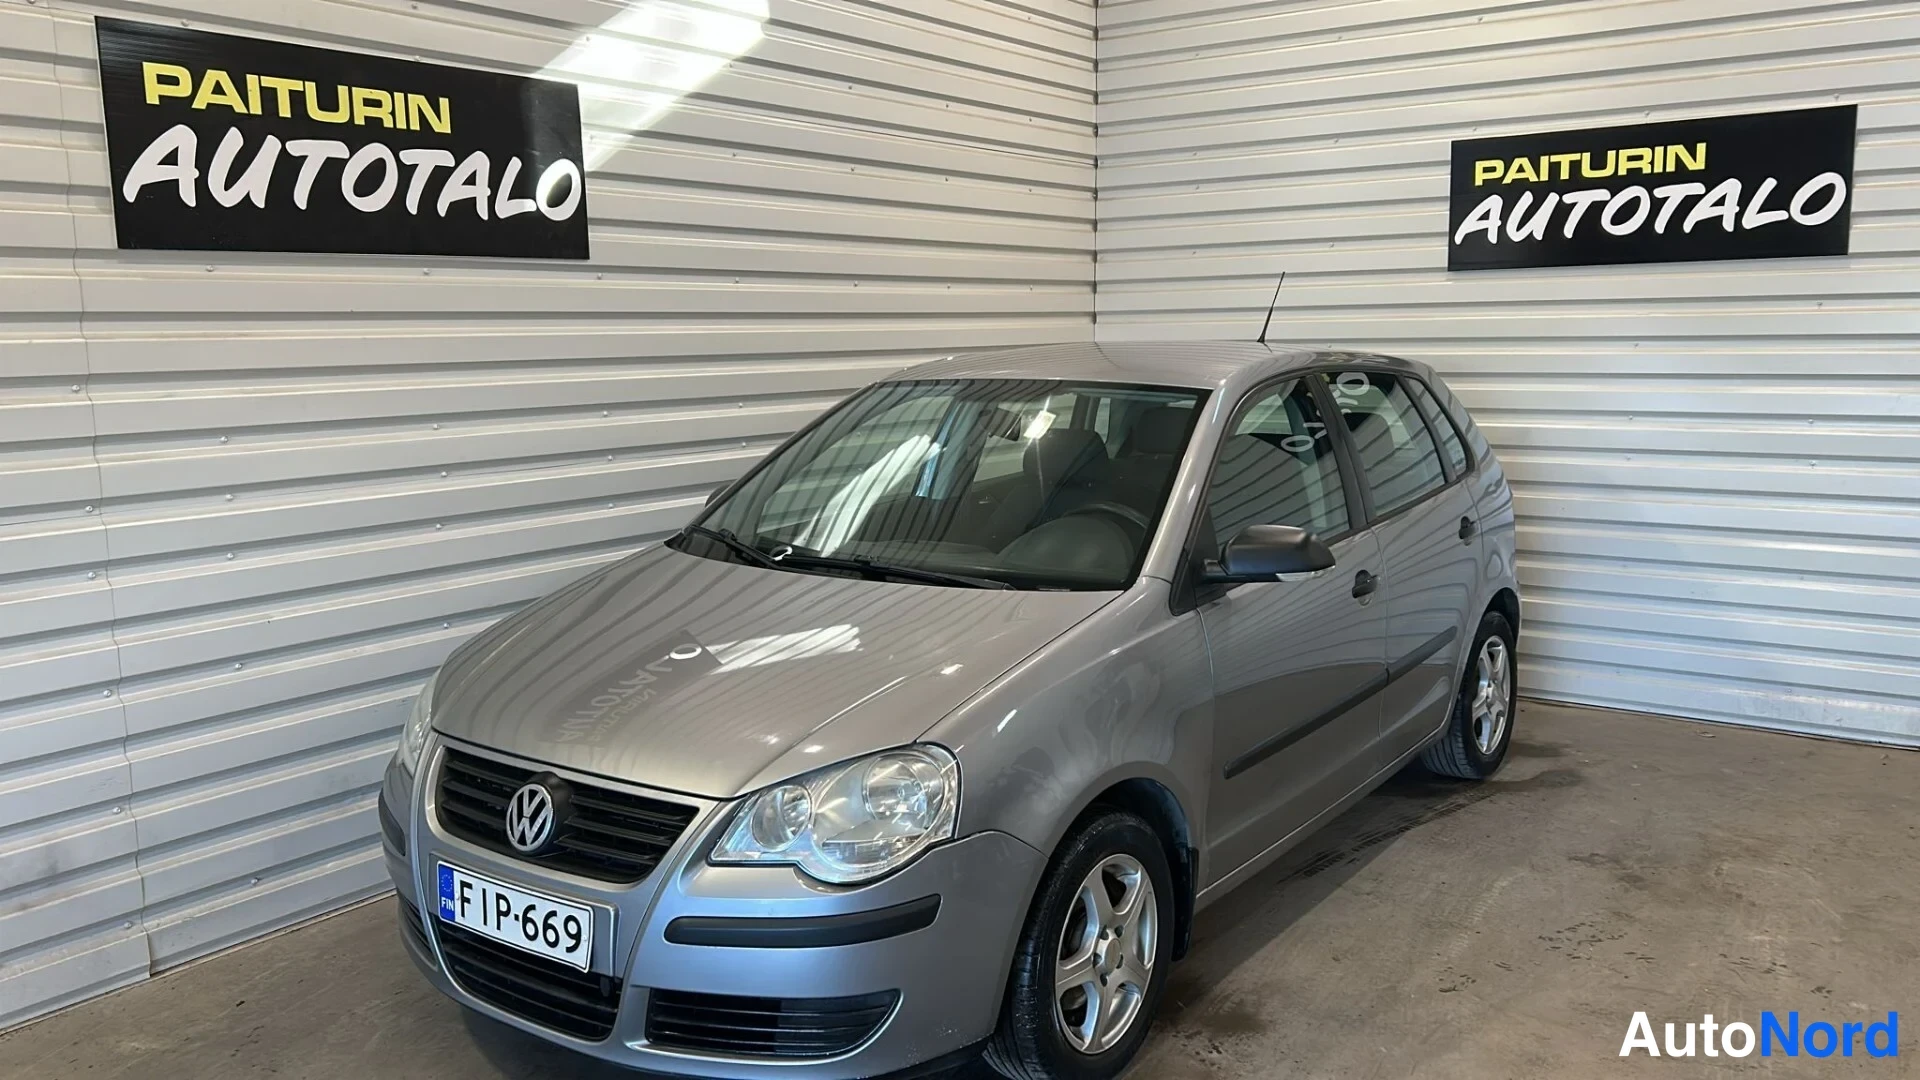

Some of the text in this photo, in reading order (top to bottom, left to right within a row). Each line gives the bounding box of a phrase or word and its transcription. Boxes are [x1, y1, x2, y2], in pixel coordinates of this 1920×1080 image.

[142, 61, 451, 134] PAITURIN
[122, 124, 581, 221] AUTOTALO
[1475, 142, 1707, 186] PAITURIN
[1454, 172, 1847, 245] AUTOTALO
[506, 783, 554, 851] VW
[441, 896, 455, 912] FIN
[459, 879, 582, 953] FIP-669
